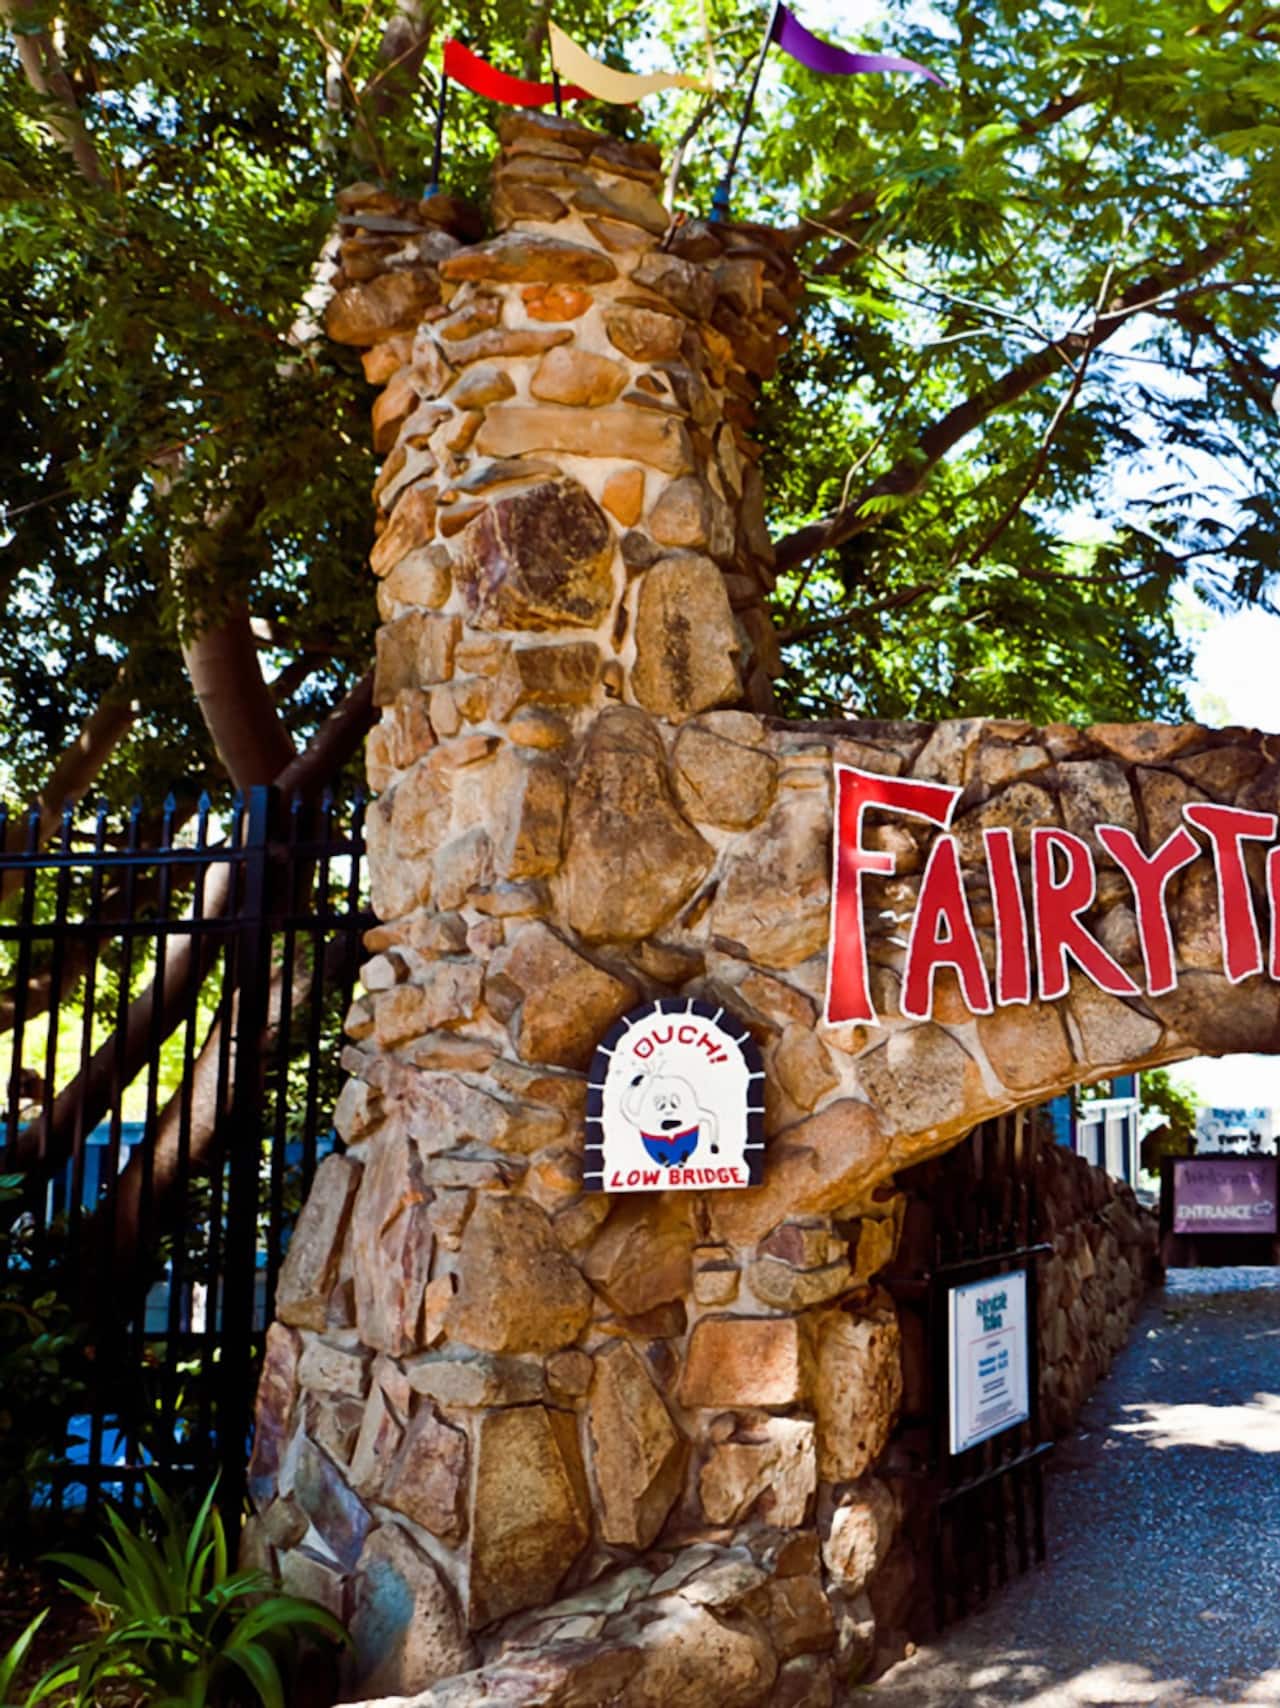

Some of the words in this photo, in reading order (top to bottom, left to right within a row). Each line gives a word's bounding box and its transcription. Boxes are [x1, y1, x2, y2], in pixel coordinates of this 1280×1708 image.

[633, 1025, 728, 1064] OUCH!
[610, 1169, 660, 1187] LOW
[668, 1167, 745, 1186] BRIDGE
[1177, 1204, 1253, 1220] ENTRANCE
